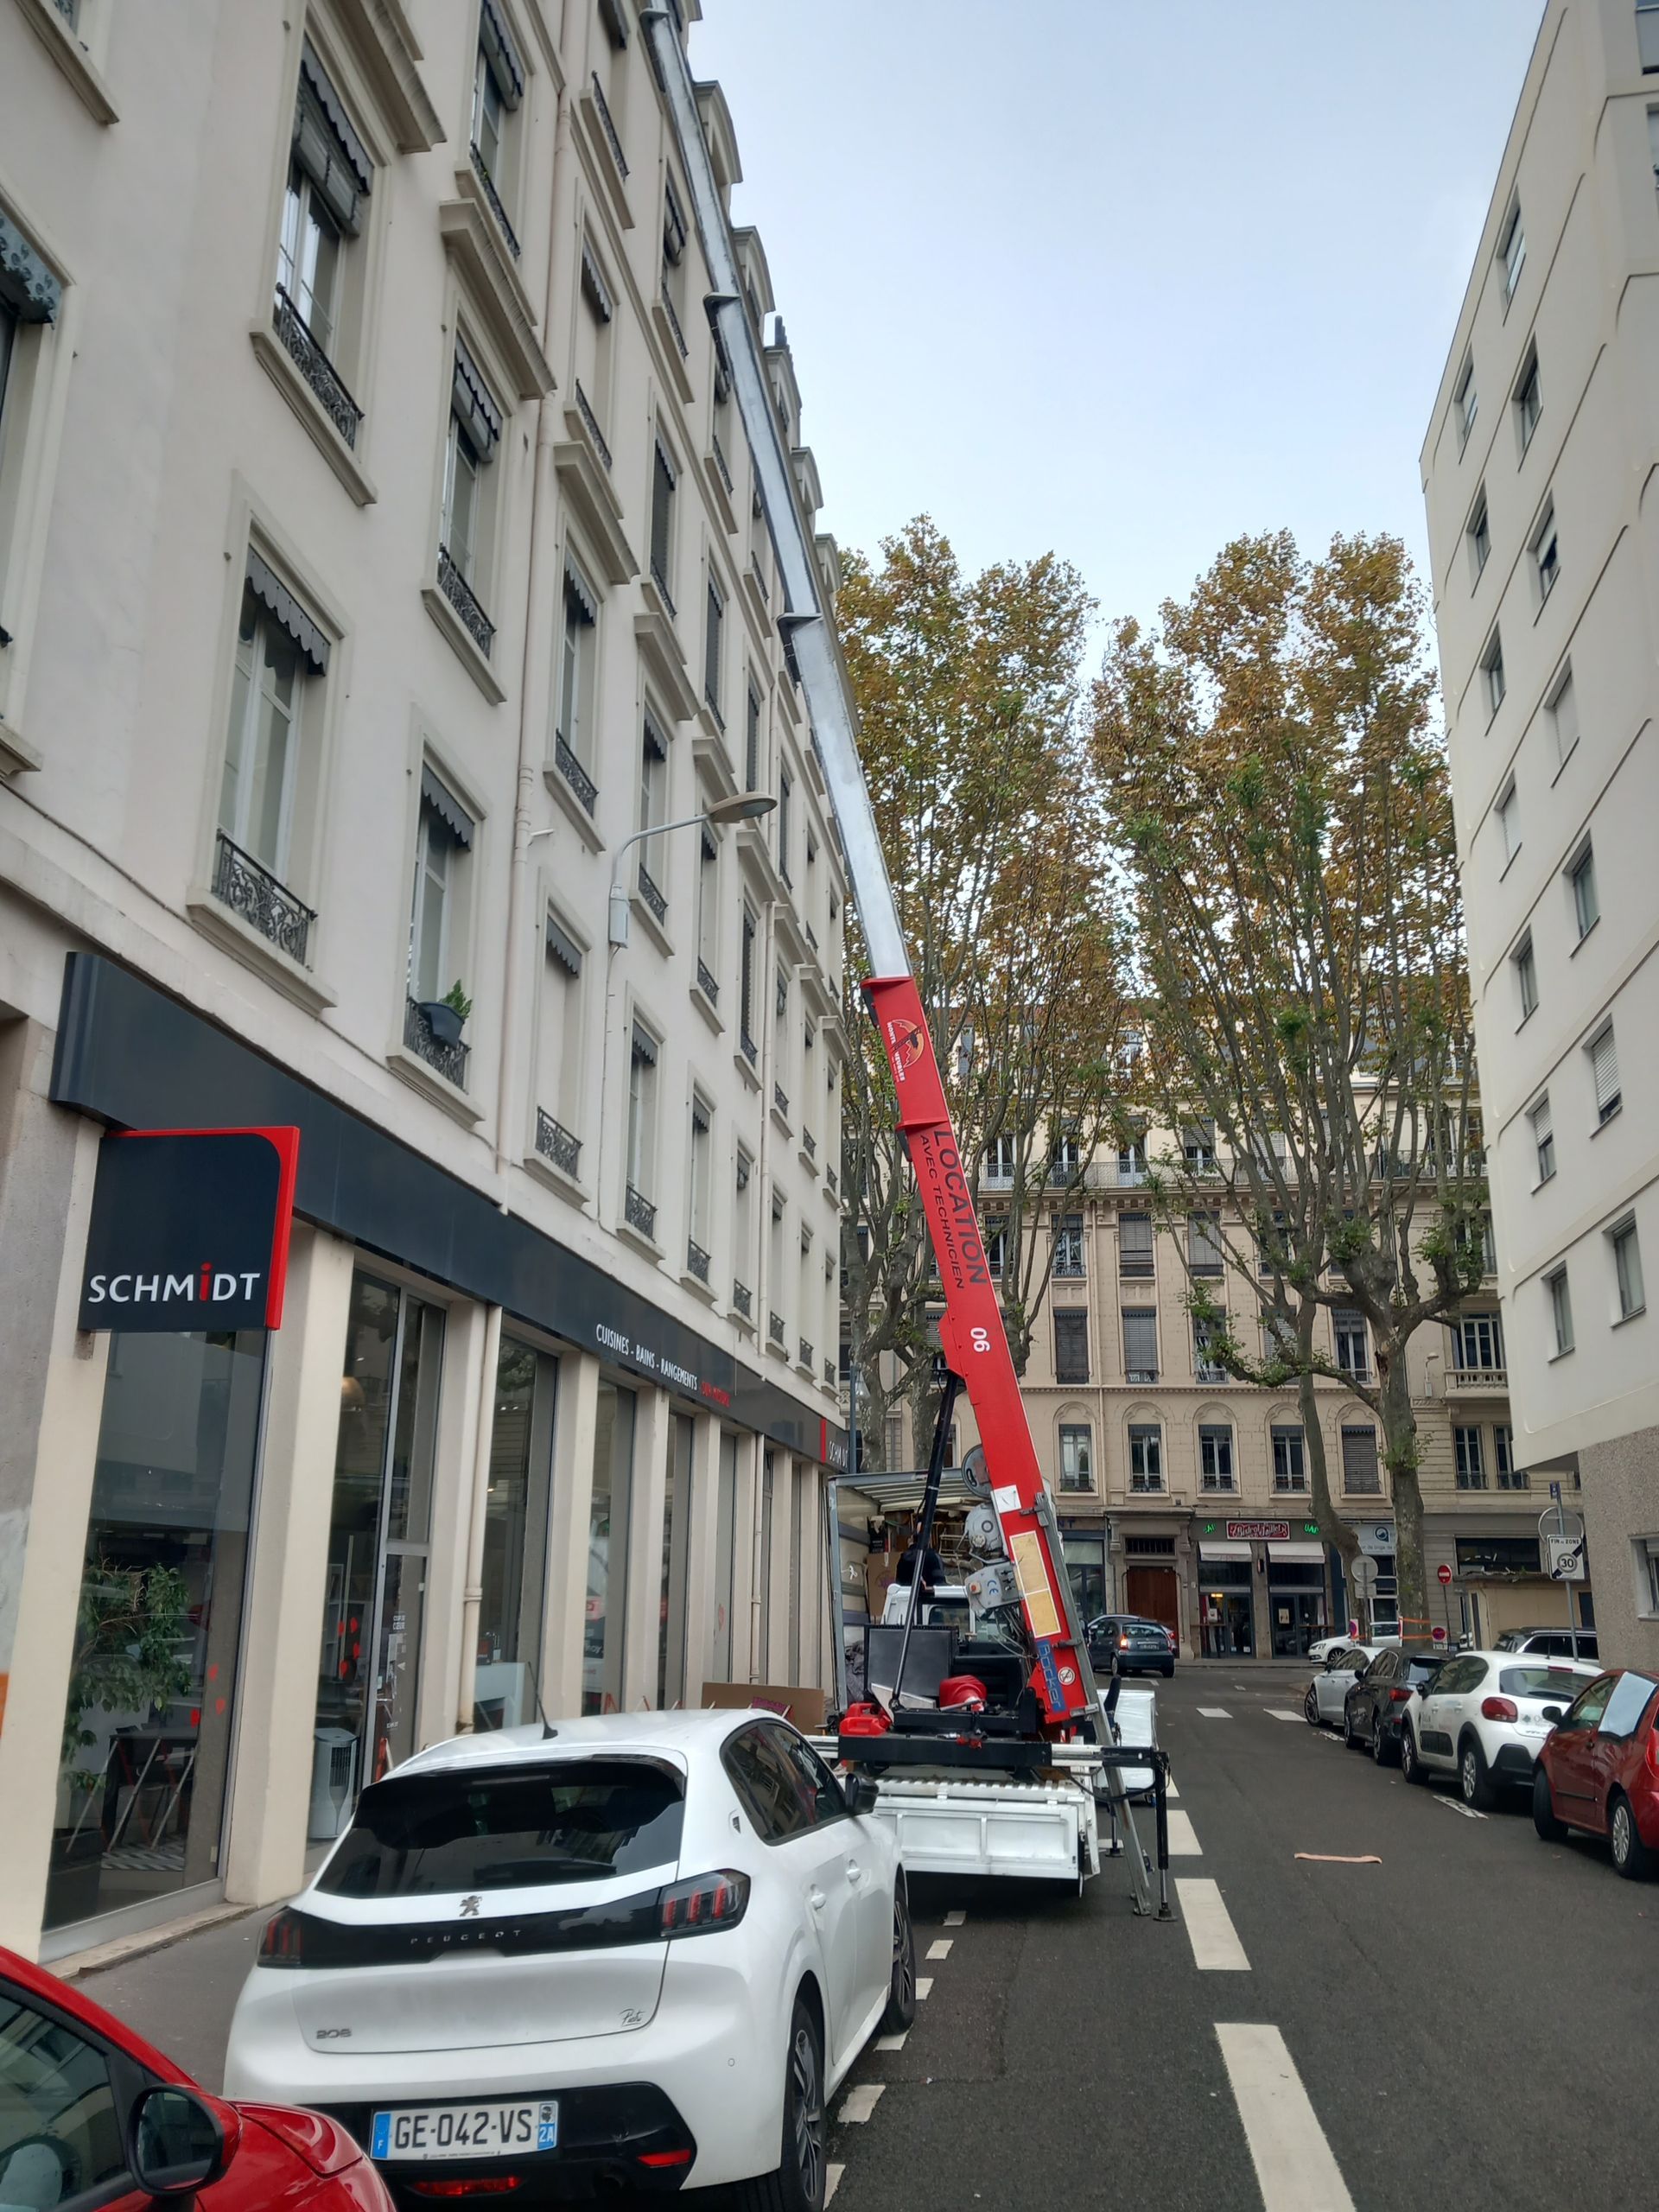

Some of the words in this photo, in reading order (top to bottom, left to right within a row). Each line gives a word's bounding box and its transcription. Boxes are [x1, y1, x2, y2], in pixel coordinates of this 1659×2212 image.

[920, 1135, 938, 1179] AVEC
[932, 1185, 964, 1288] TECHNICIEN
[934, 1130, 988, 1285] LOCATION
[970, 1327, 990, 1352] 06
[596, 1324, 629, 1356] CUISINES
[636, 1344, 655, 1369] BAINS
[661, 1358, 697, 1390] RANGEMENTS
[1561, 1558, 1574, 1567] 30
[410, 1929, 521, 1944] PEUGEOT
[316, 2028, 353, 2039] 208
[395, 2109, 532, 2149] GE-042-VS
[539, 2126, 554, 2143] 2A
[377, 2139, 384, 2150] F
